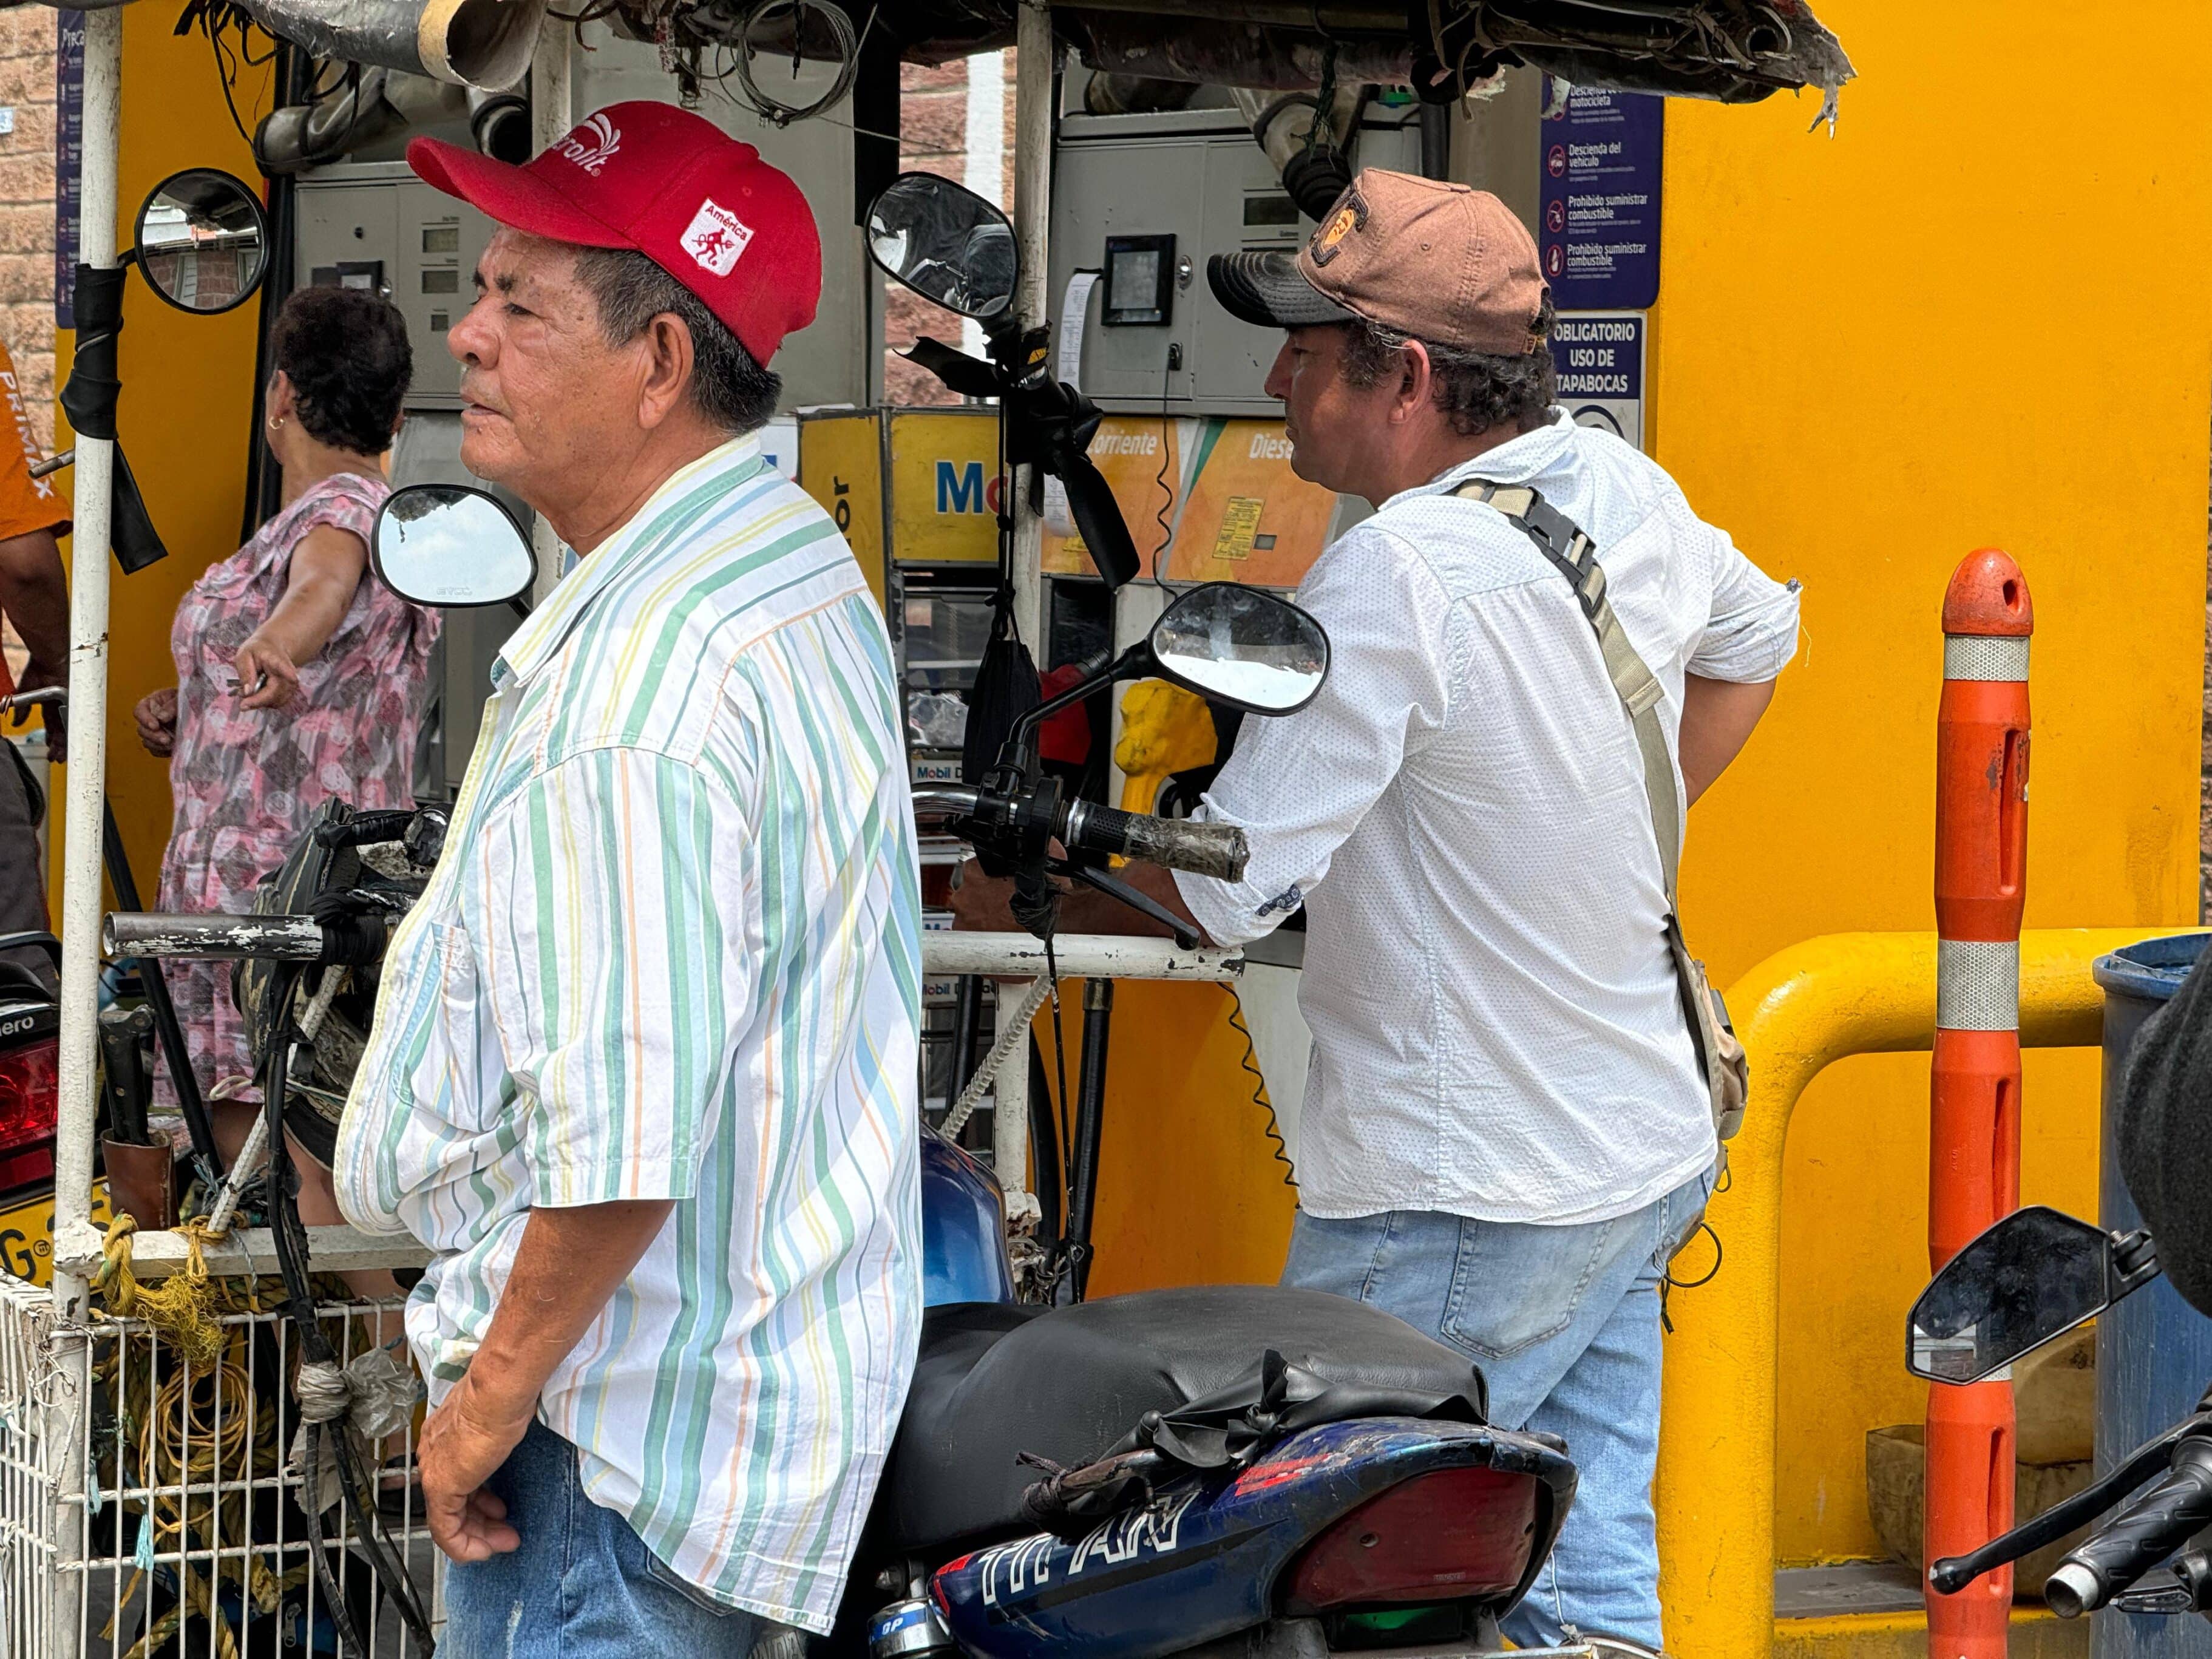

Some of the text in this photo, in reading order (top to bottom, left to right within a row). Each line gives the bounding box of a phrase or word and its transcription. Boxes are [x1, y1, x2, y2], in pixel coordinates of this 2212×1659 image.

[1570, 96, 1611, 107] motocicleta
[1569, 141, 1621, 156] Descienda del
[1568, 192, 1648, 208] Prohibido suministrar
[1568, 208, 1615, 220] combustible
[705, 205, 748, 241] América
[1567, 242, 1647, 256] Prohibido suministrar
[1567, 254, 1613, 266] combustible
[1554, 323, 1635, 342] OBLIGATORIO
[1570, 348, 1615, 367] USO DE
[1556, 374, 1629, 393] TAPABOCAS
[917, 767, 951, 779] Mobil
[0, 1016, 35, 1037] ero
